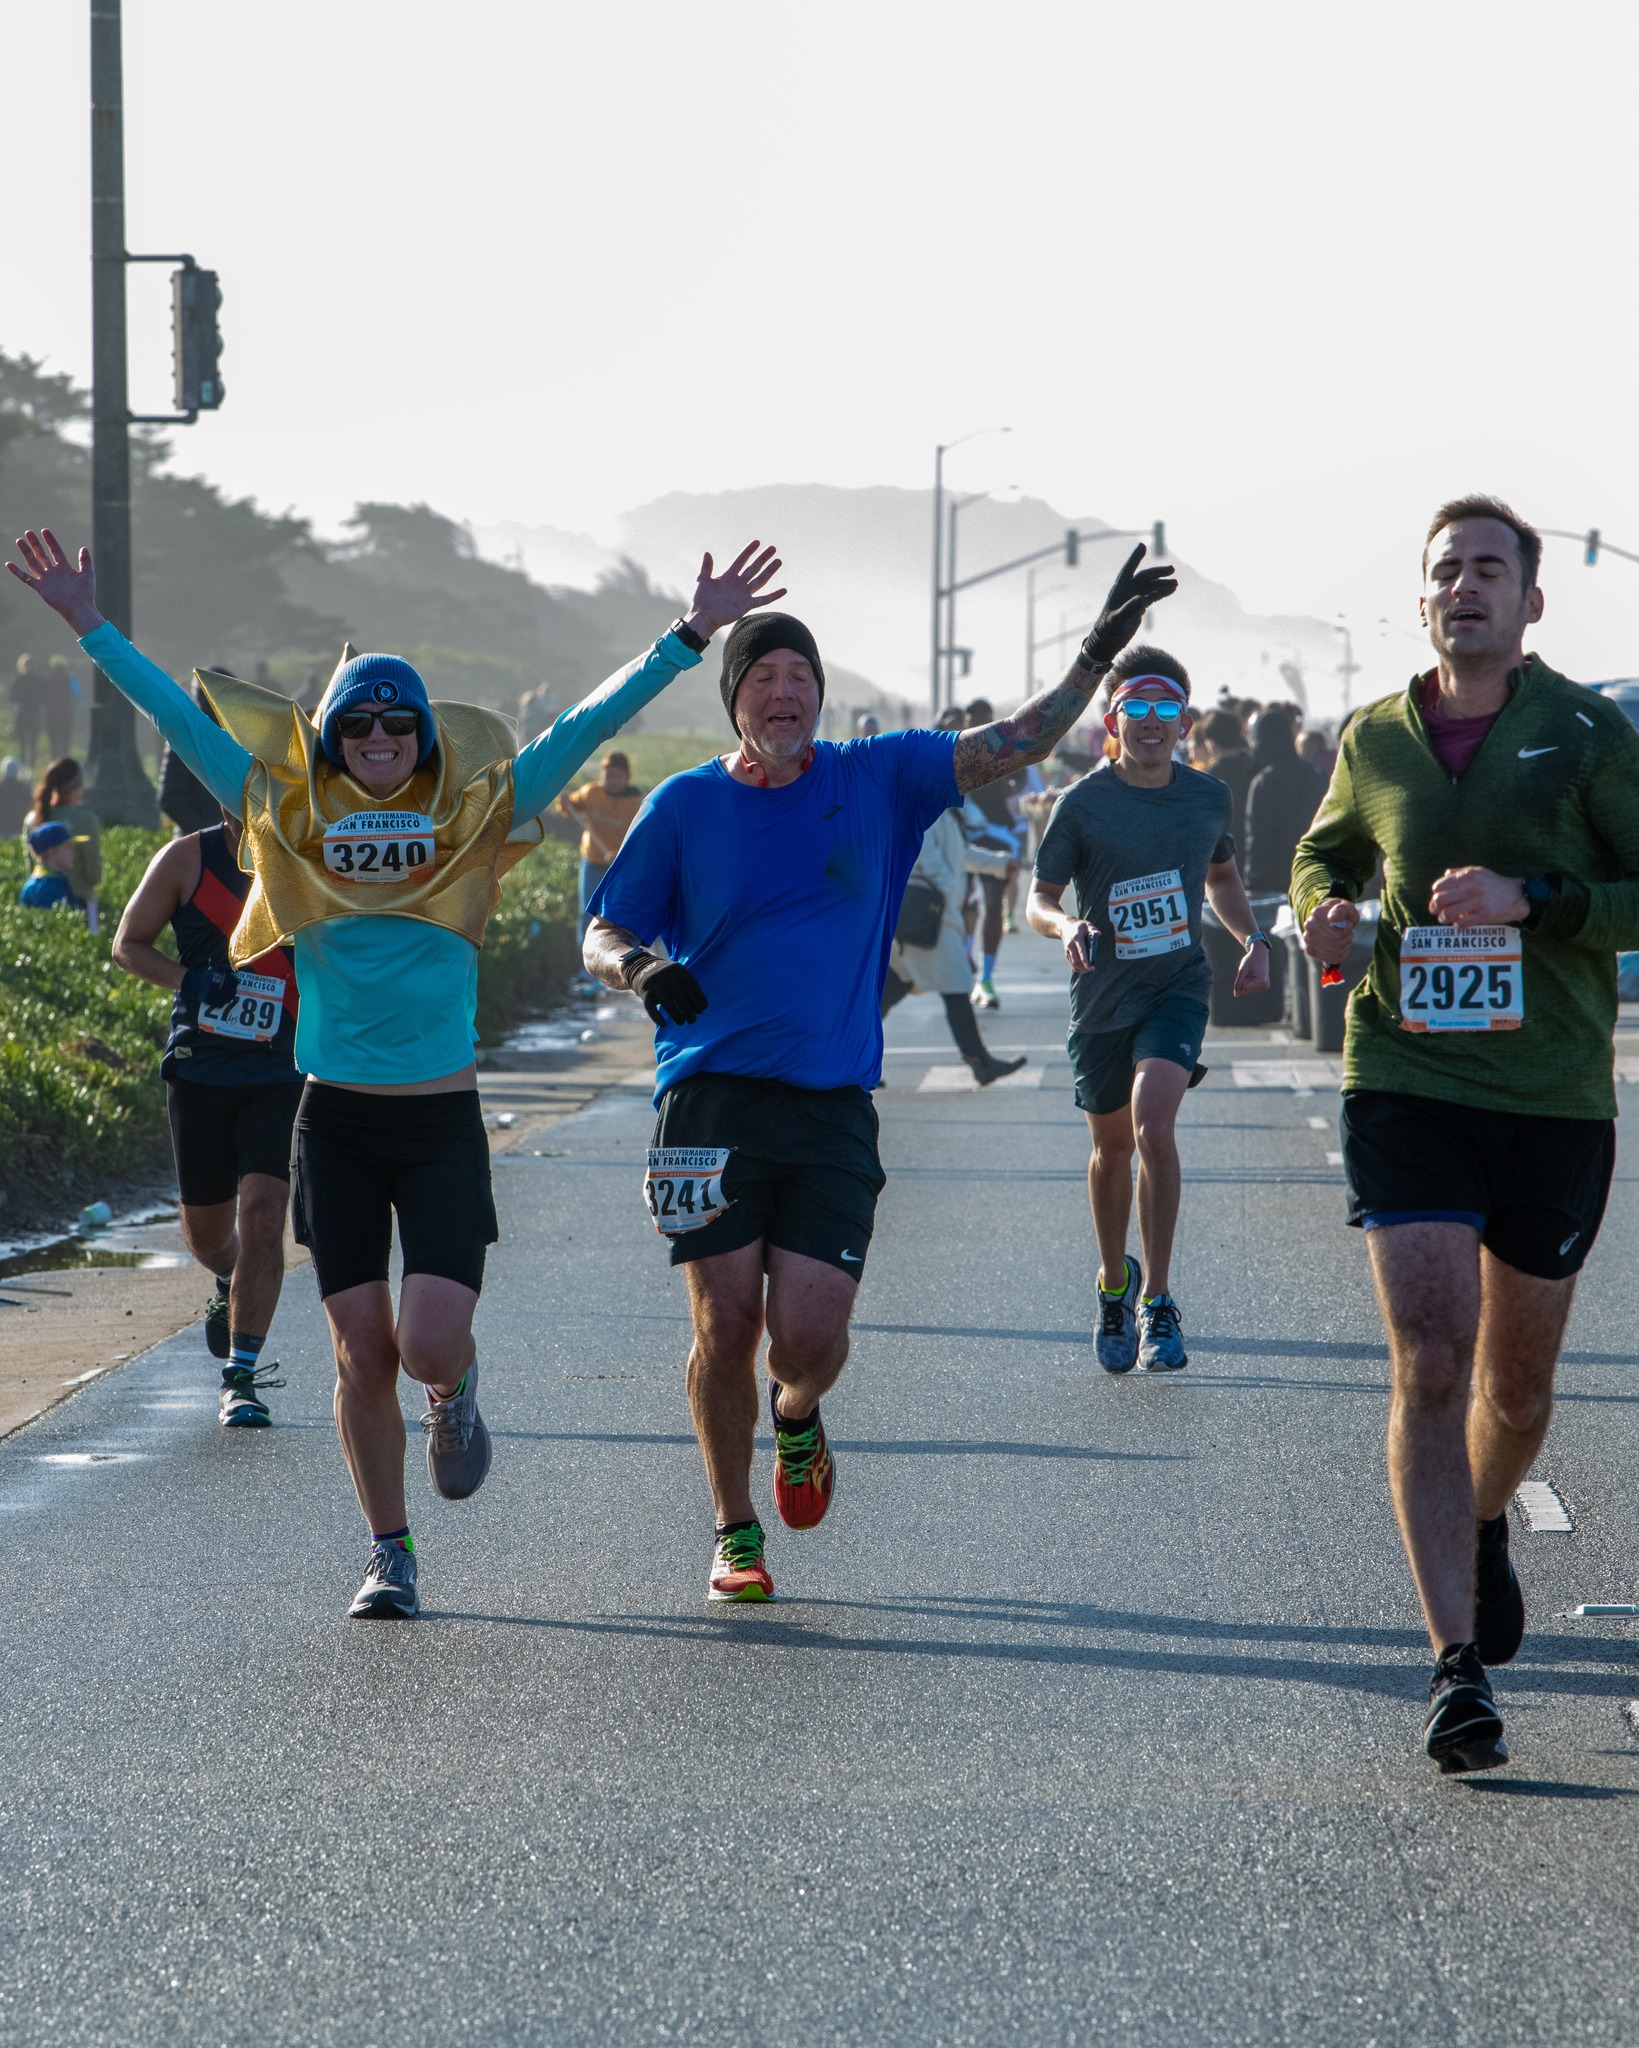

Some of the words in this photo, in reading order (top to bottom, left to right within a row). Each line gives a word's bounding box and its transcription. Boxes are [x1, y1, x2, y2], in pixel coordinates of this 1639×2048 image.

[378, 812, 419, 820] PERMANENTE
[337, 821, 356, 831] SAN
[361, 820, 420, 829] FRANCISCO
[333, 841, 426, 873] 3240
[1126, 879, 1141, 887] KAISER
[1142, 873, 1171, 884] PERMANENTE
[1114, 888, 1129, 897] SAN
[1131, 878, 1172, 893] FRANCISCO
[1114, 895, 1182, 932] 2951
[1412, 929, 1427, 937] 2023
[1430, 928, 1455, 937] KAISER
[1457, 927, 1506, 936] PERMANENTE
[1170, 938, 1185, 949] 2951
[1412, 938, 1431, 949] SAN
[1437, 937, 1506, 948] FRANCISCO
[246, 973, 277, 985] PERMANENTE
[1408, 965, 1512, 1010] 2925
[679, 1149, 718, 1157] PERMANENTE
[648, 1157, 659, 1166] AN
[663, 1157, 717, 1166] FRANCISCO
[646, 1179, 718, 1216] 3241
